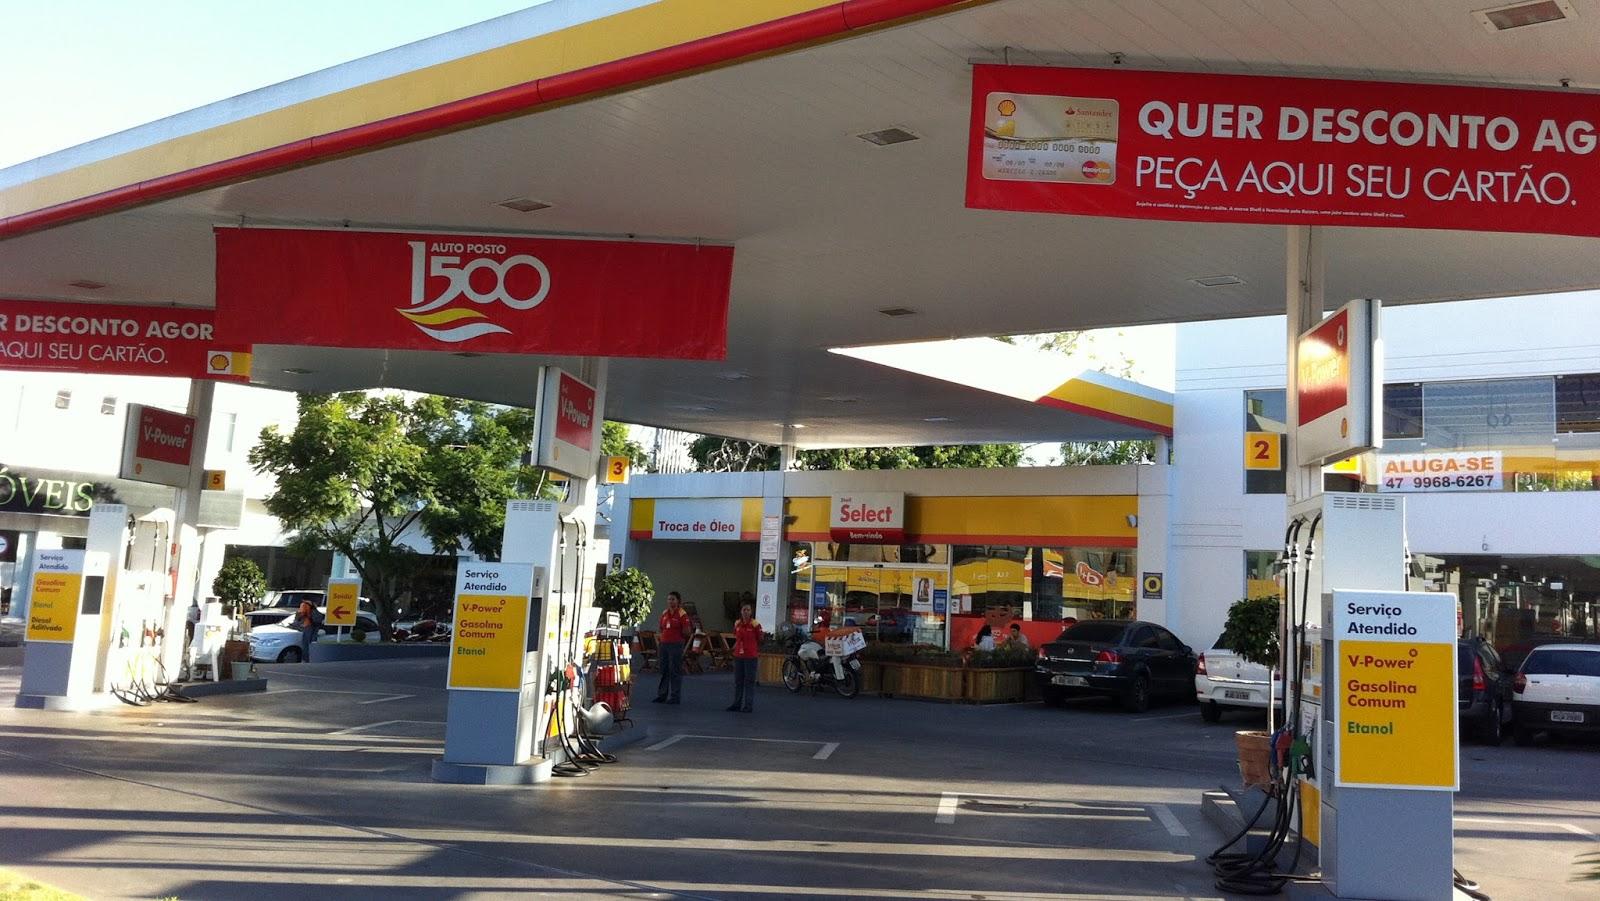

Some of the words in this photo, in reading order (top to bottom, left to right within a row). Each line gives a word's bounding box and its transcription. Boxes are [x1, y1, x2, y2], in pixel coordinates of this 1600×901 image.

[1138, 100, 1263, 140] QUER
[1278, 105, 1519, 151] DESCONTO
[1136, 155, 1229, 200] PEÇA
[1235, 160, 1333, 197] AQUI
[1345, 163, 1410, 199] SEU
[1423, 164, 1577, 206] CARTÃO.
[431, 243, 464, 253] AUTO
[467, 243, 506, 254] POSTO
[405, 241, 550, 311] 1500
[15, 314, 139, 336] DESCONTO
[48, 342, 82, 360] SEU
[88, 342, 168, 364] CARTÃO.
[561, 396, 590, 428] V-Power
[144, 424, 187, 448] V-Power
[1254, 440, 1269, 460] 2
[613, 461, 623, 475] 3
[1385, 456, 1494, 474] ALUGA-SE
[212, 474, 220, 484] 5
[1386, 476, 1404, 488] 47
[1414, 475, 1493, 488] 9968-6267
[840, 503, 893, 522] Select
[658, 520, 689, 532] Troca
[692, 520, 706, 532] de
[709, 519, 735, 533] Óleo
[465, 570, 499, 580] Serviço
[464, 582, 507, 592] Atendido
[462, 603, 503, 614] V-Power
[1347, 602, 1402, 619] Serviço
[460, 619, 503, 630] Gasolina
[1347, 622, 1417, 636] Atendido
[460, 629, 496, 639] Comum
[457, 646, 486, 656] Etanol
[1348, 654, 1414, 670] V-Power
[1347, 679, 1417, 694] Gasolina
[1347, 694, 1406, 709] Comum
[1347, 721, 1394, 735] Etanol
